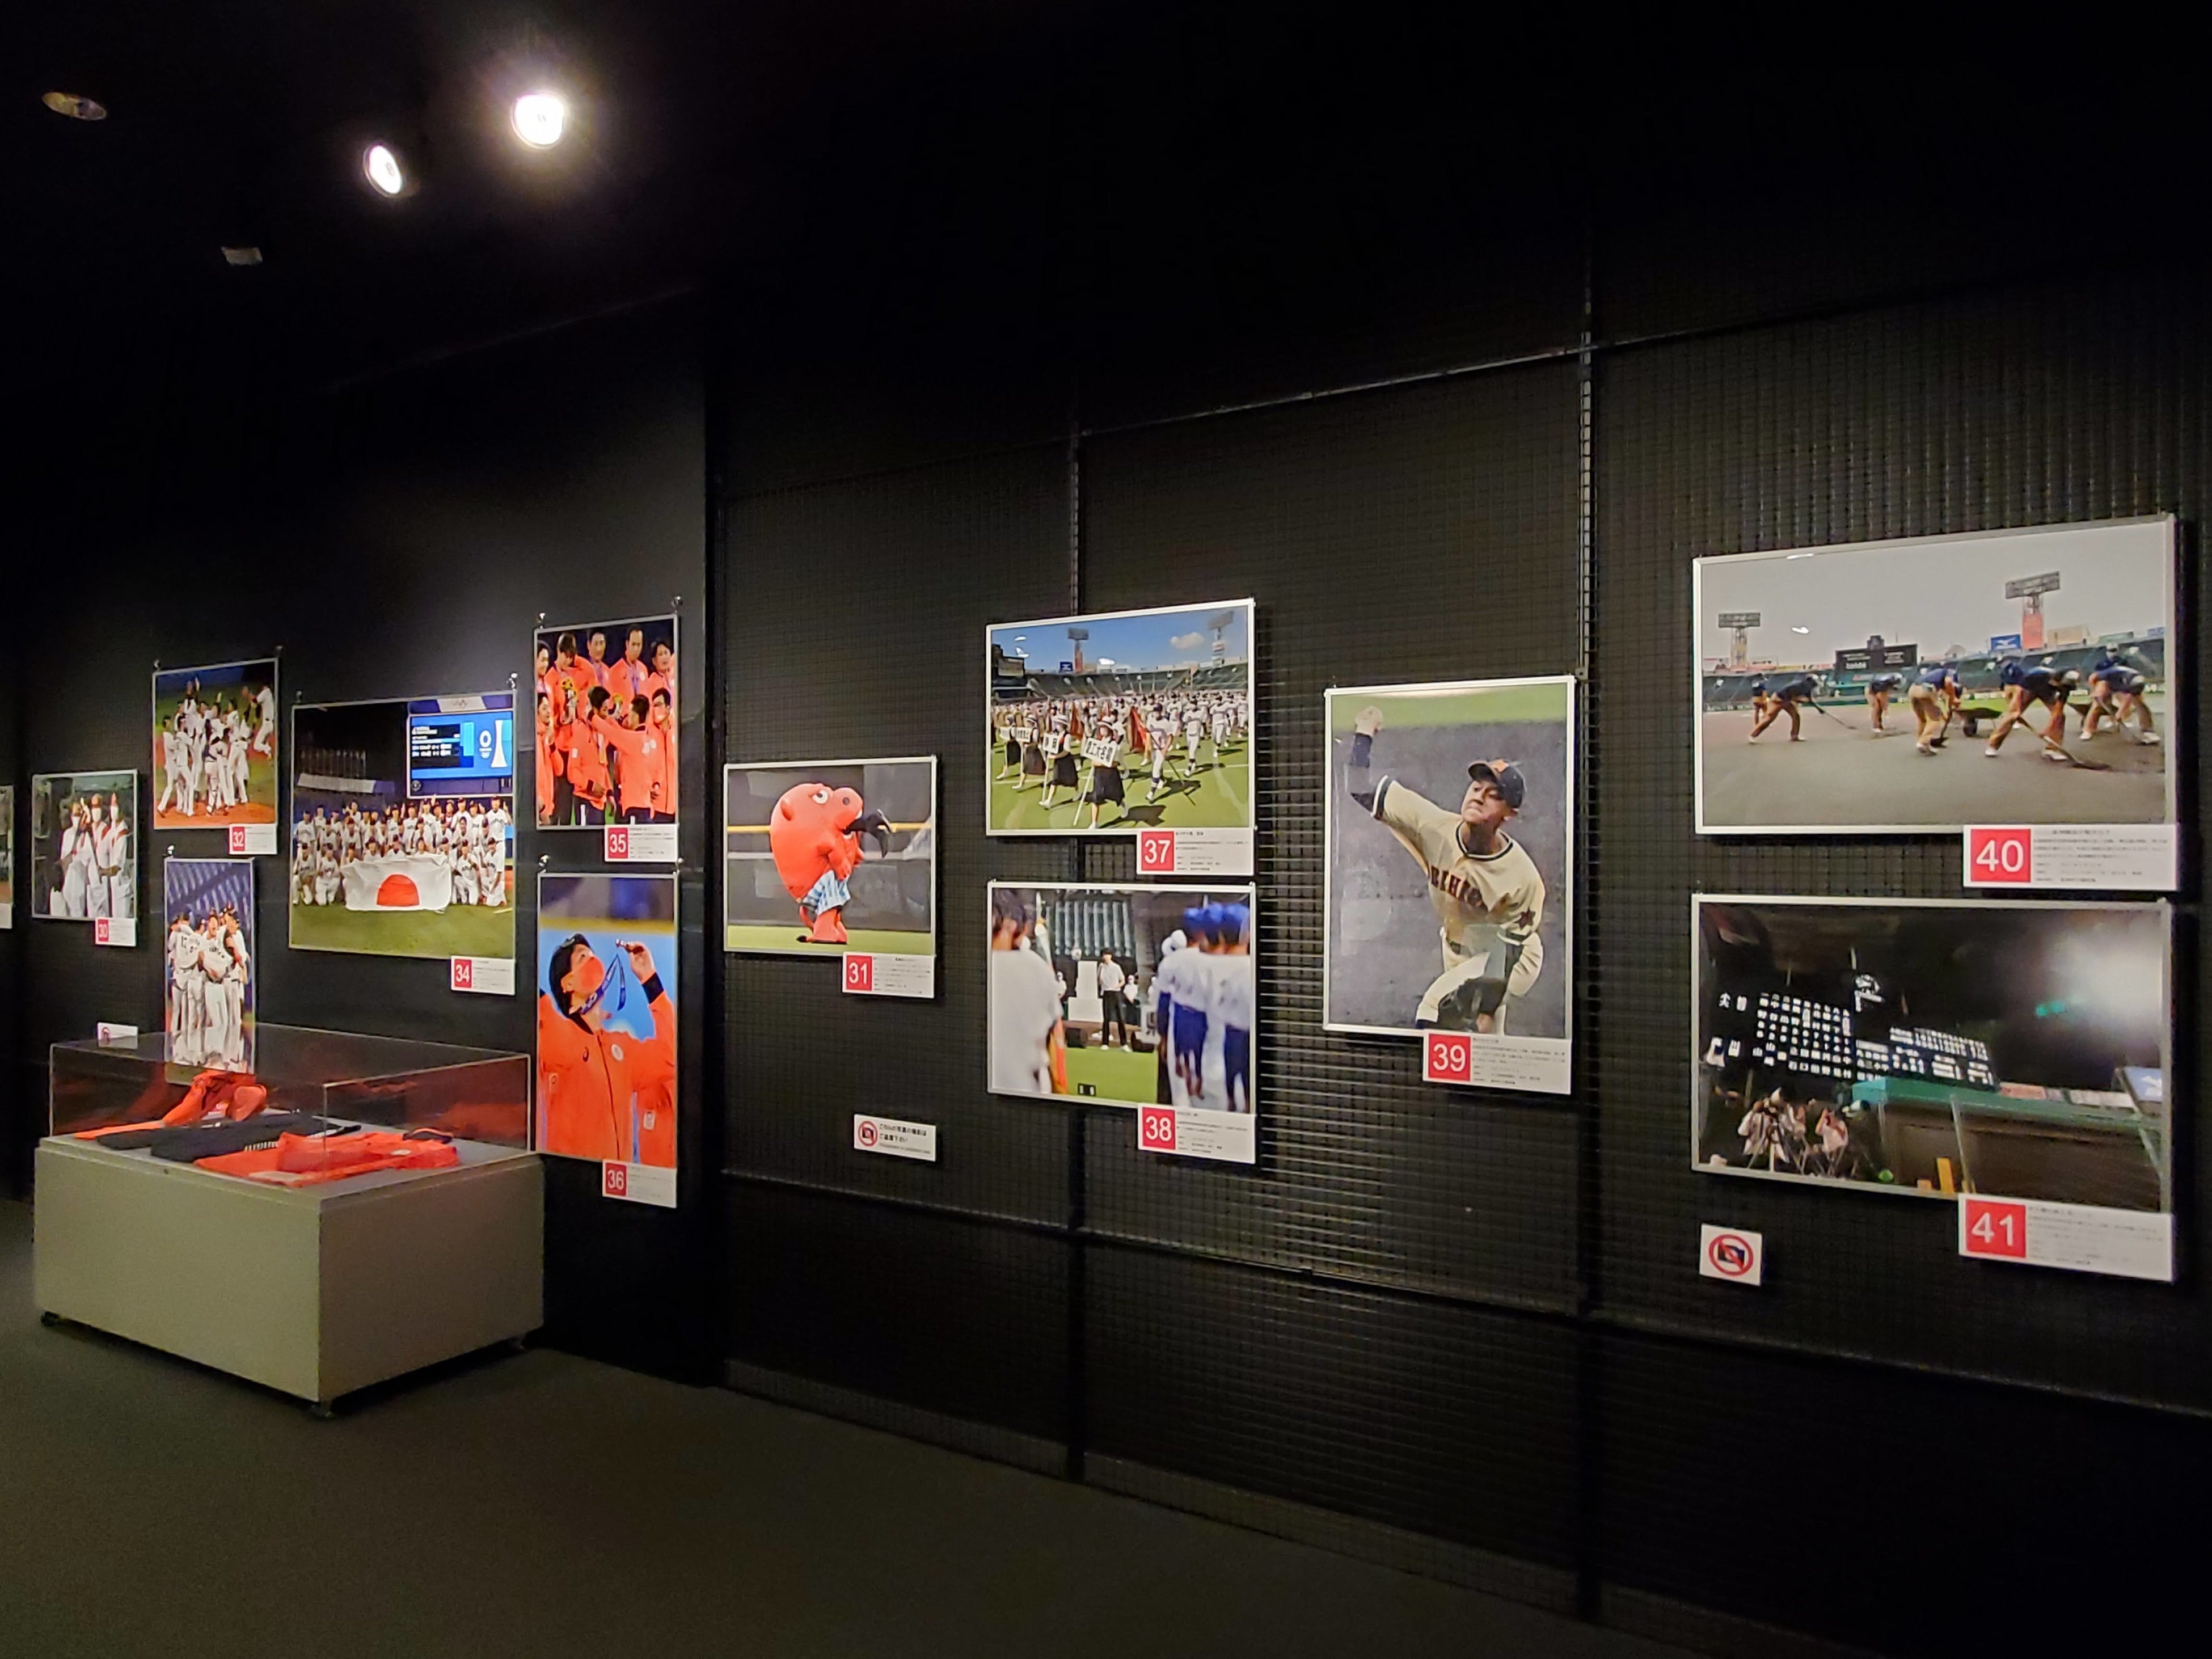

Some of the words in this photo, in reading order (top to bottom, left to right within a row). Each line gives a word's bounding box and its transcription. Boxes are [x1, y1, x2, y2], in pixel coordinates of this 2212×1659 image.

[233, 831, 244, 847] 32
[609, 834, 626, 853] 35
[1145, 839, 1171, 864] 37
[1976, 840, 2024, 872] 40
[455, 964, 470, 982] 34
[849, 962, 868, 985] 31
[1433, 1043, 1466, 1072] 39
[1146, 1116, 1172, 1141] 38
[607, 1169, 624, 1191] 36
[1972, 1212, 2013, 1246] 41
